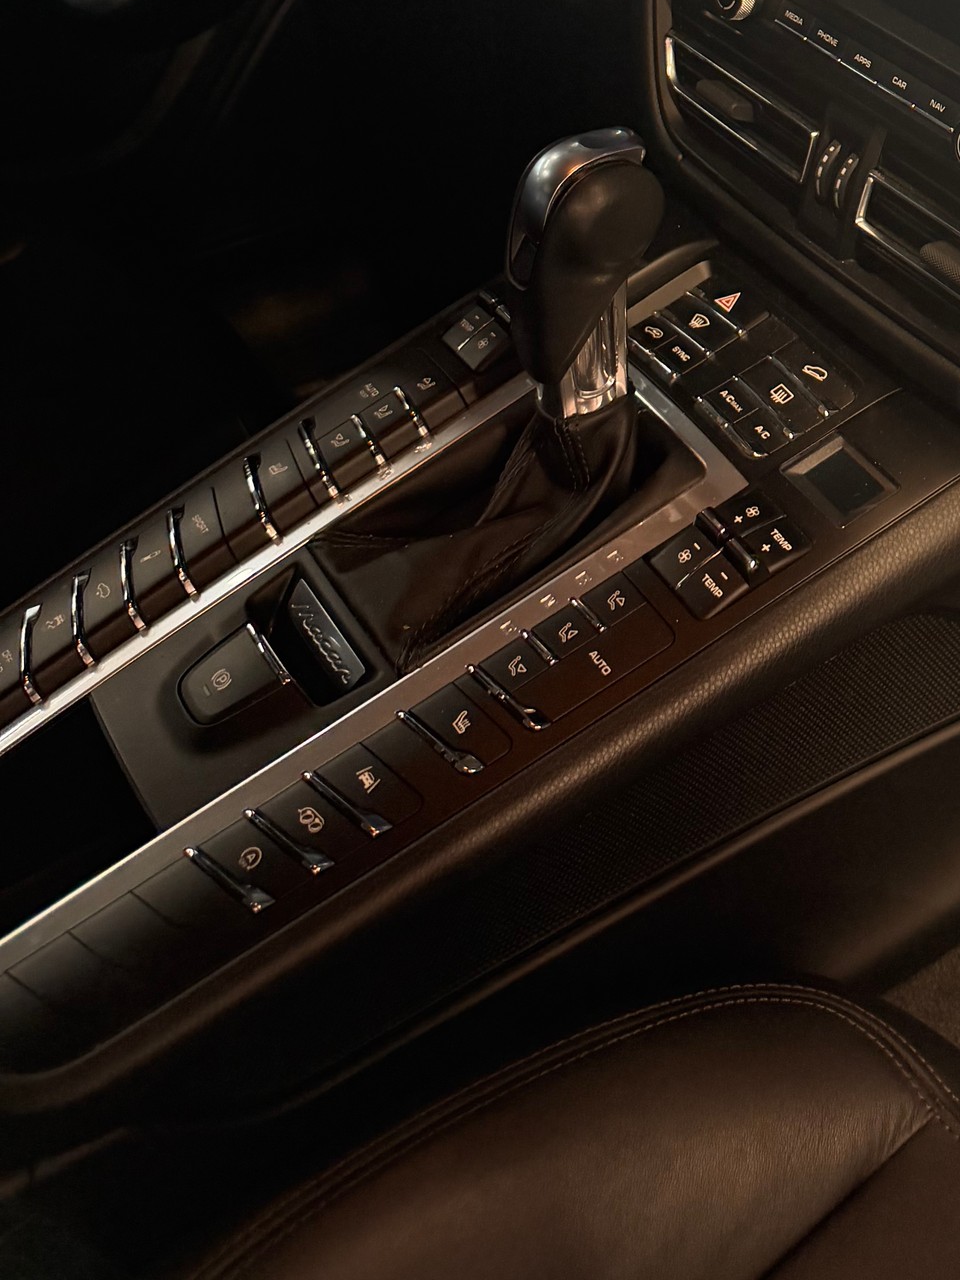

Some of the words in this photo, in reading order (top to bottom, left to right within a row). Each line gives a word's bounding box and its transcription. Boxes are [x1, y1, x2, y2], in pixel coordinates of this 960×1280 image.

[784, 9, 804, 26] MEDIA
[816, 29, 839, 47] PHONE
[853, 53, 872, 68] APPS
[891, 75, 908, 90] CAR
[929, 99, 946, 113] NAV
[671, 345, 691, 362] SYNC
[754, 425, 771, 440] A/C
[770, 528, 793, 551] TEMP
[701, 573, 724, 598] TEMP
[588, 650, 612, 676] AUTO
